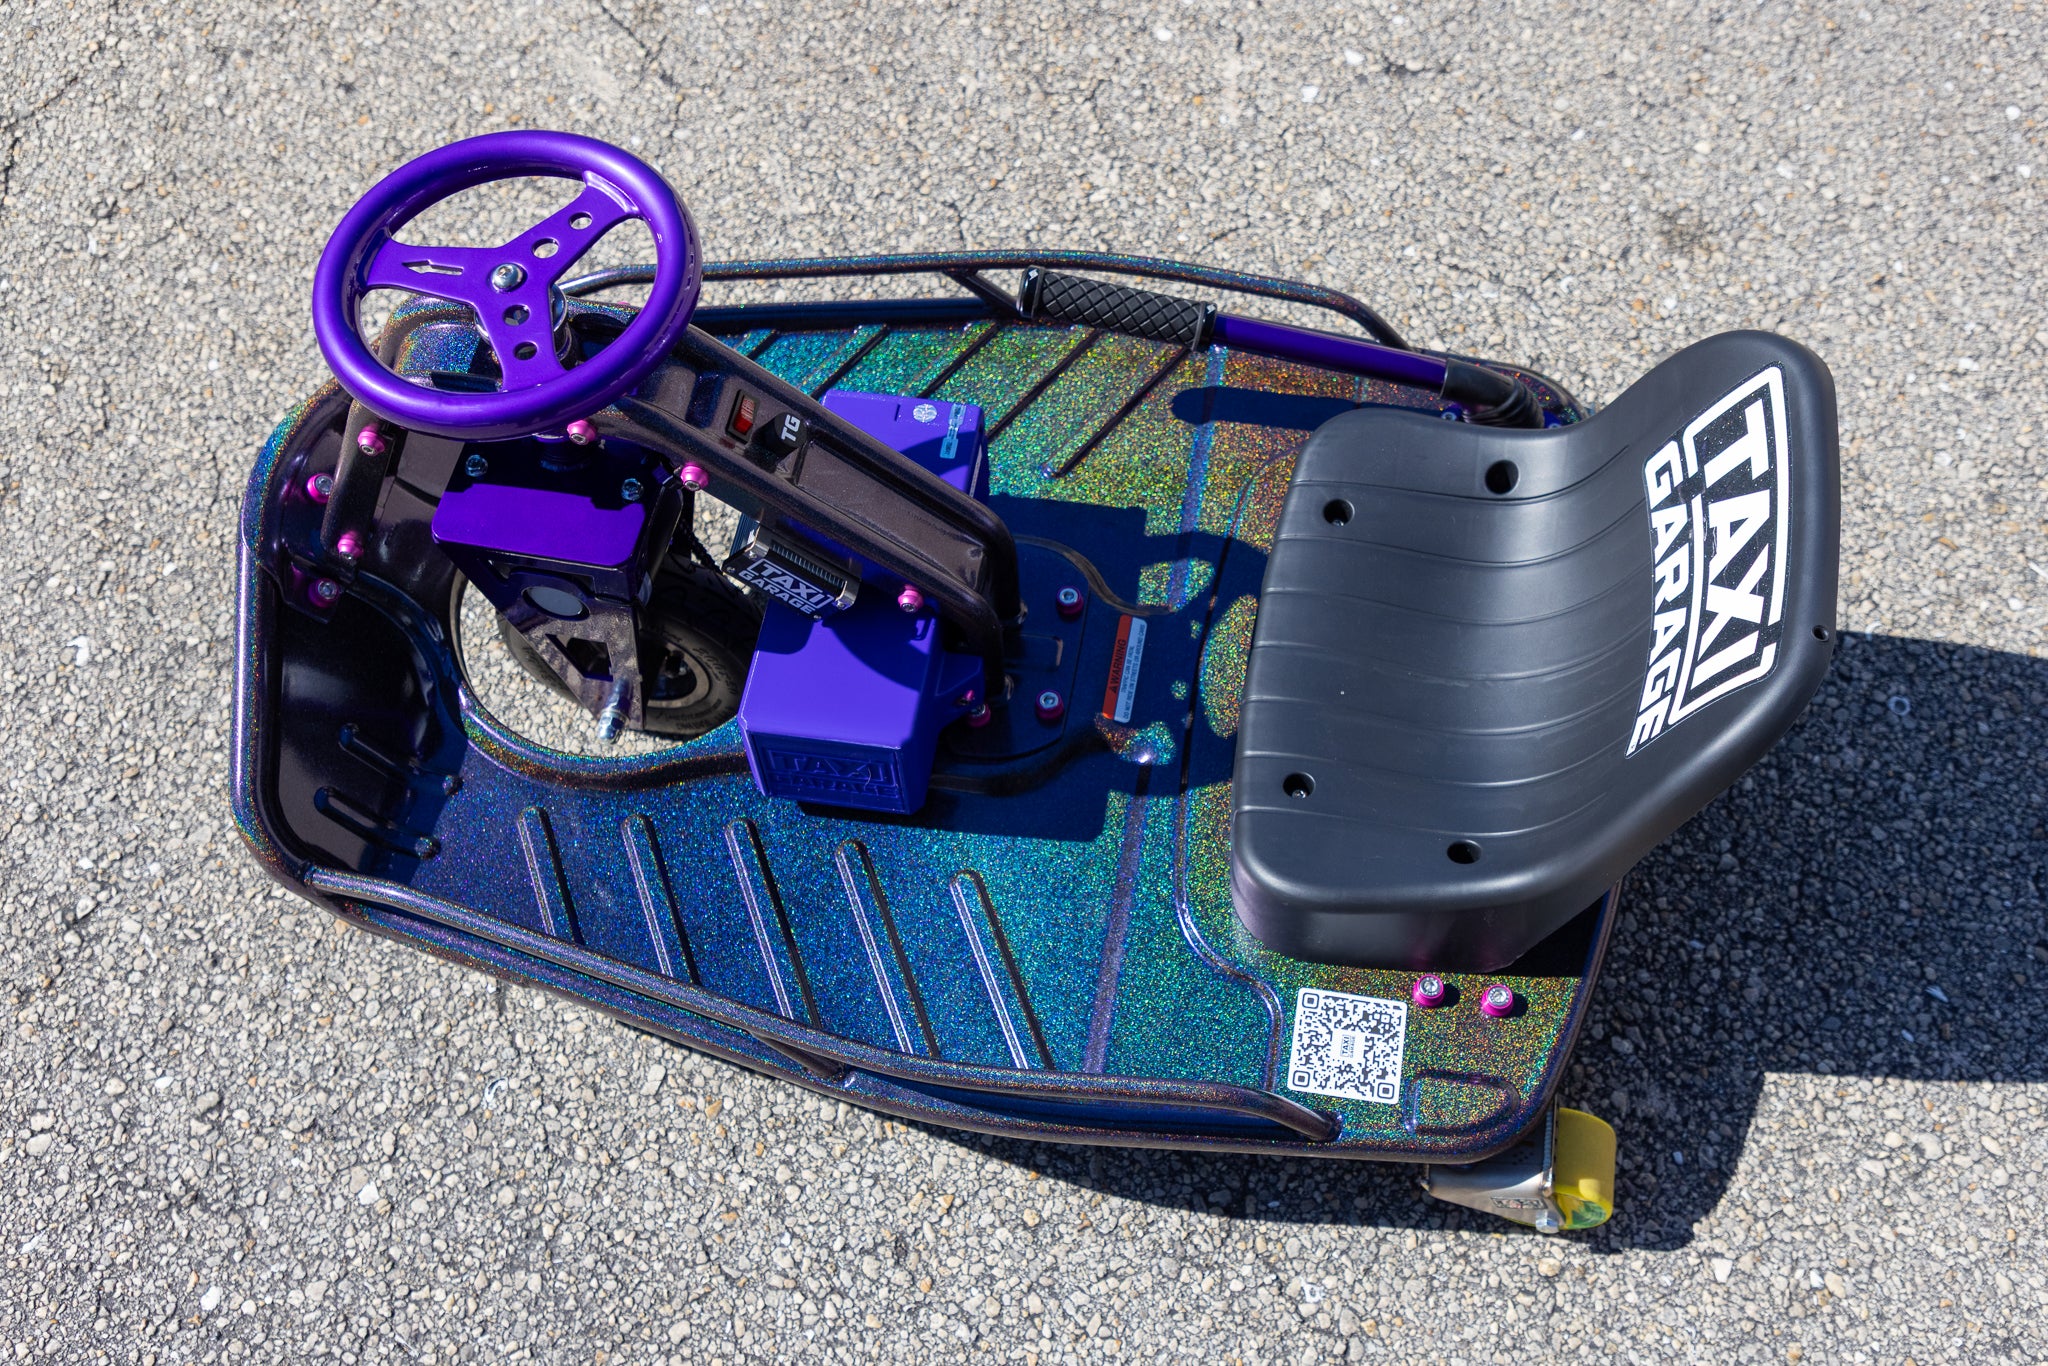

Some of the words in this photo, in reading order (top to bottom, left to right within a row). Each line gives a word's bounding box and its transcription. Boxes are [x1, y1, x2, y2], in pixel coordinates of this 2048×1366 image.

[781, 414, 800, 441] TG
[1691, 398, 1770, 690] TAXI
[738, 570, 815, 614] GARAGE
[761, 564, 824, 603] TAXI
[1626, 440, 1690, 756] GARAGE
[1111, 639, 1126, 684] WARNING
[774, 755, 884, 781] TAXI
